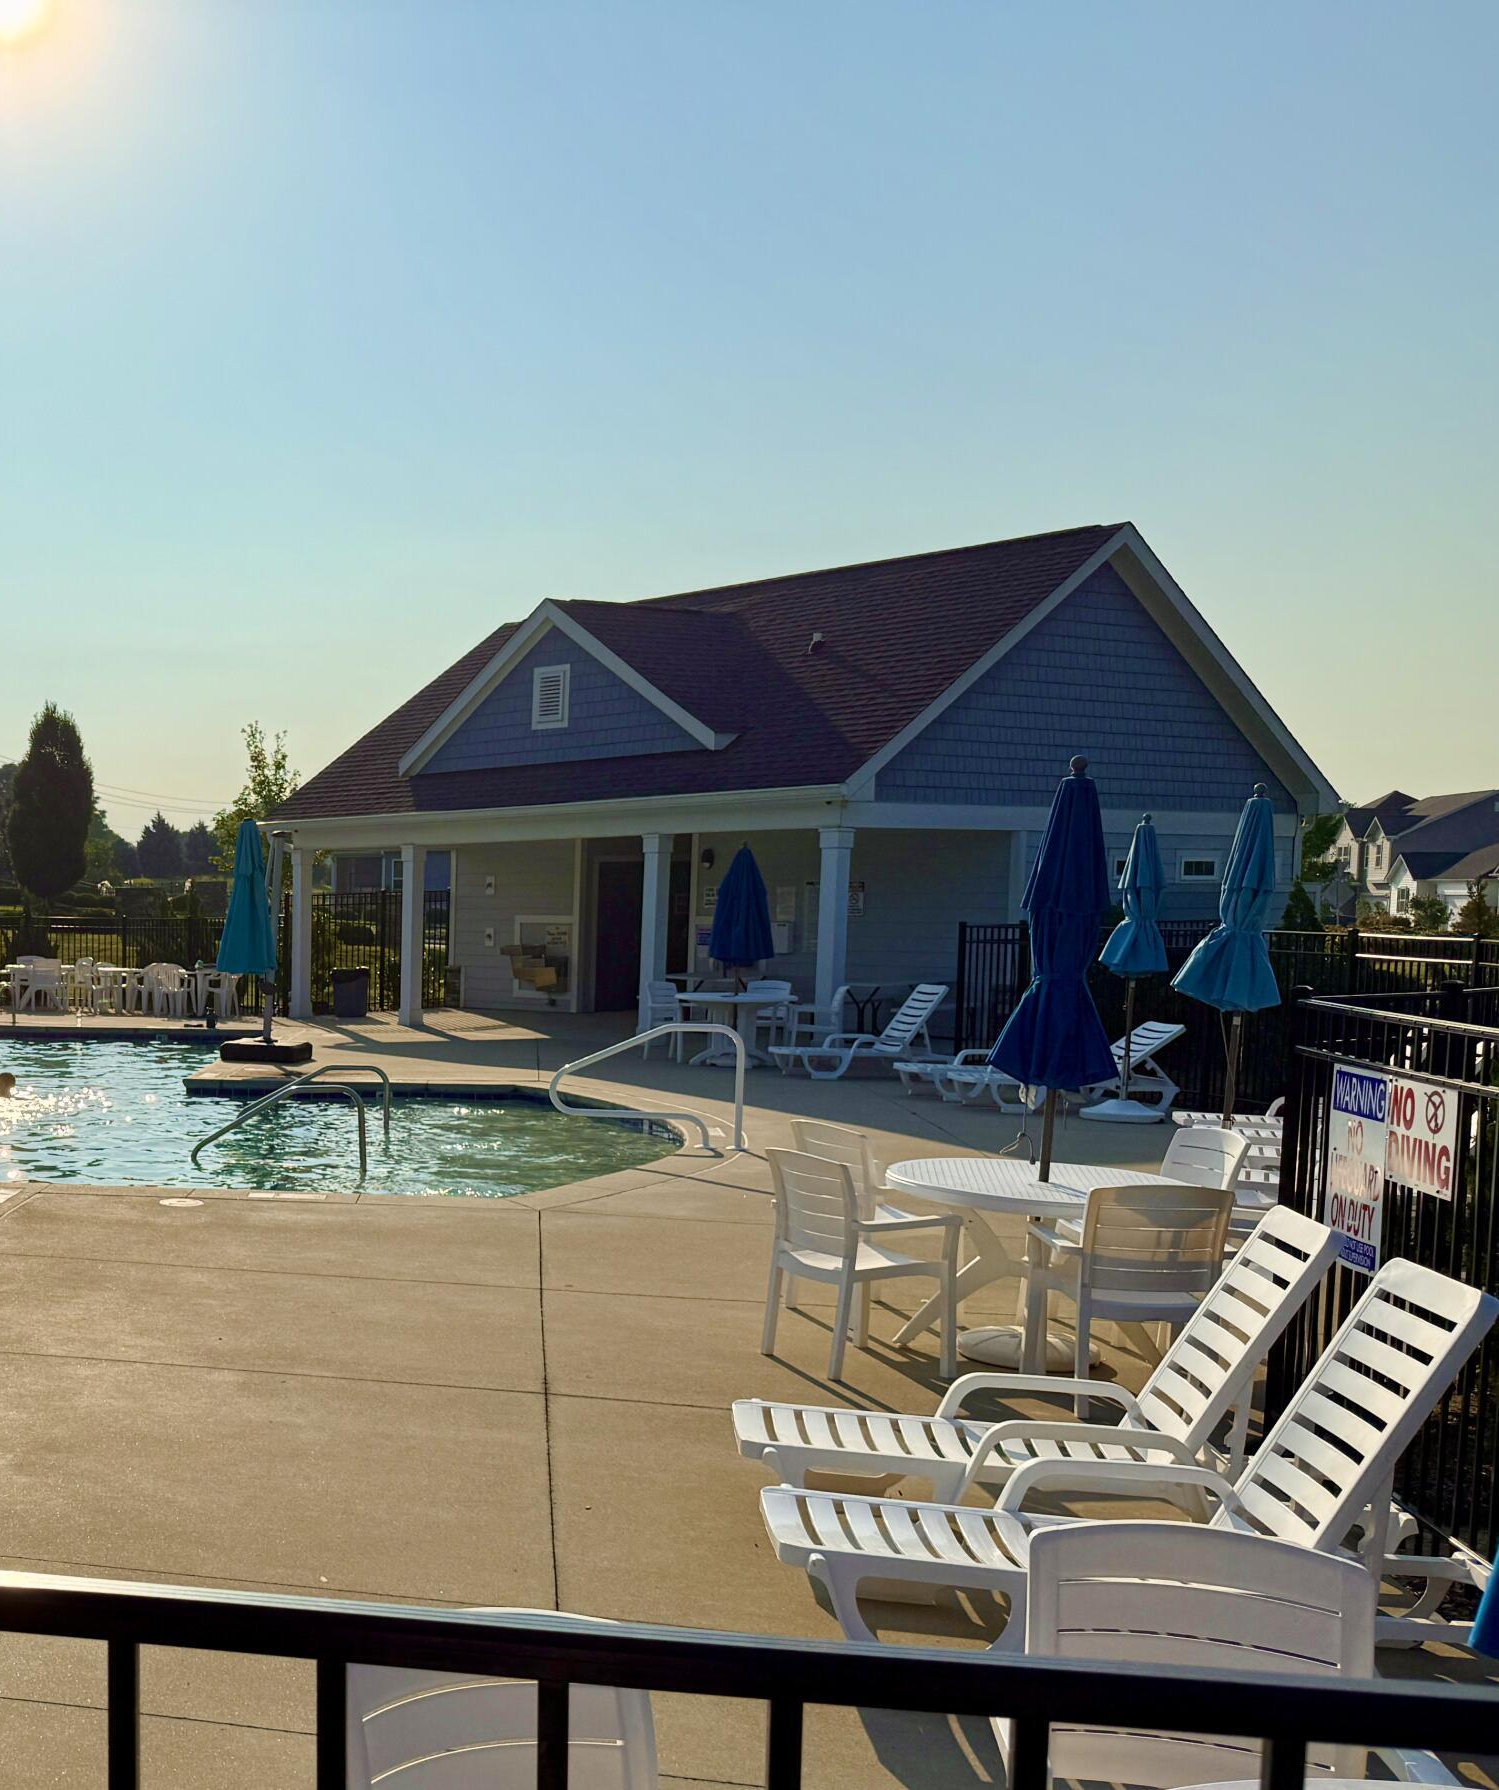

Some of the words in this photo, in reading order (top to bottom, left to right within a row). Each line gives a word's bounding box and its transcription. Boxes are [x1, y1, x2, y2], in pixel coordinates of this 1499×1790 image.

[1336, 1073, 1385, 1120] WARNING
[1390, 1084, 1416, 1131] NO
[1347, 1120, 1363, 1155] NO
[1387, 1130, 1451, 1190] DIVING
[1331, 1192, 1347, 1230] ON
[1347, 1199, 1375, 1241] DUTY
